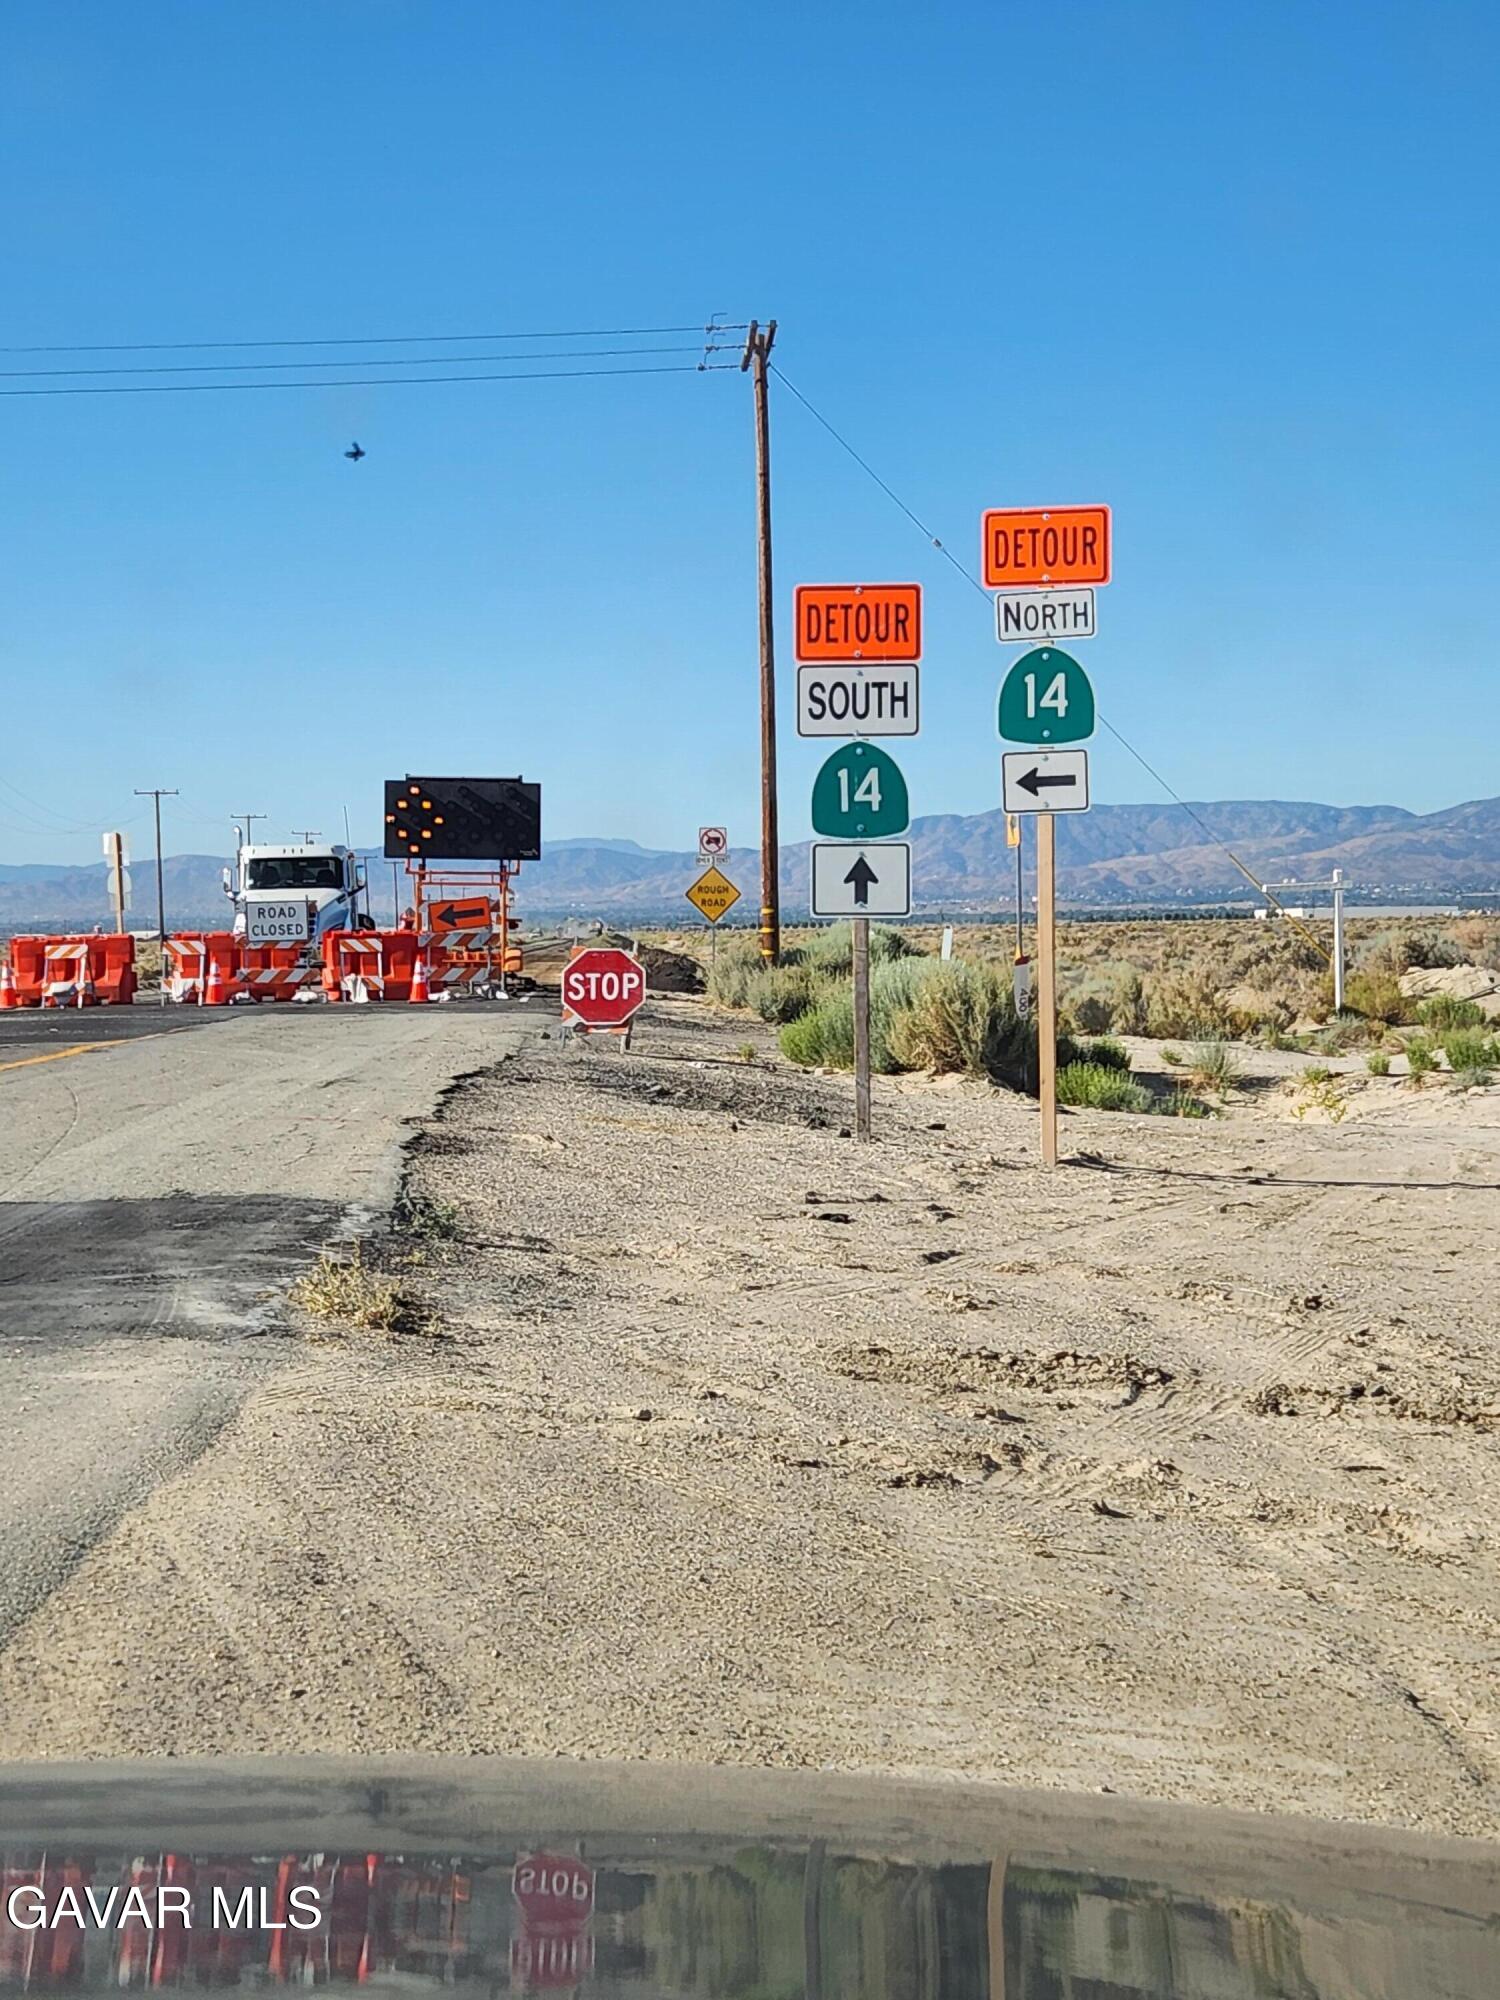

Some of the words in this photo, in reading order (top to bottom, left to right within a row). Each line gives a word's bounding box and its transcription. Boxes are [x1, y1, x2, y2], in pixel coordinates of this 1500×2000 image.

[995, 526, 1097, 569] DETOUR
[807, 603, 909, 643] DETOUR
[1003, 602, 1088, 633] NORTH
[808, 681, 909, 721] SOUTH
[1025, 672, 1069, 718] 14
[838, 767, 882, 813] 14
[697, 885, 729, 895] ROUGH
[700, 898, 726, 907] ROAD
[257, 906, 297, 919] ROAD
[251, 923, 304, 937] CLOSED
[567, 972, 640, 1001] STOP
